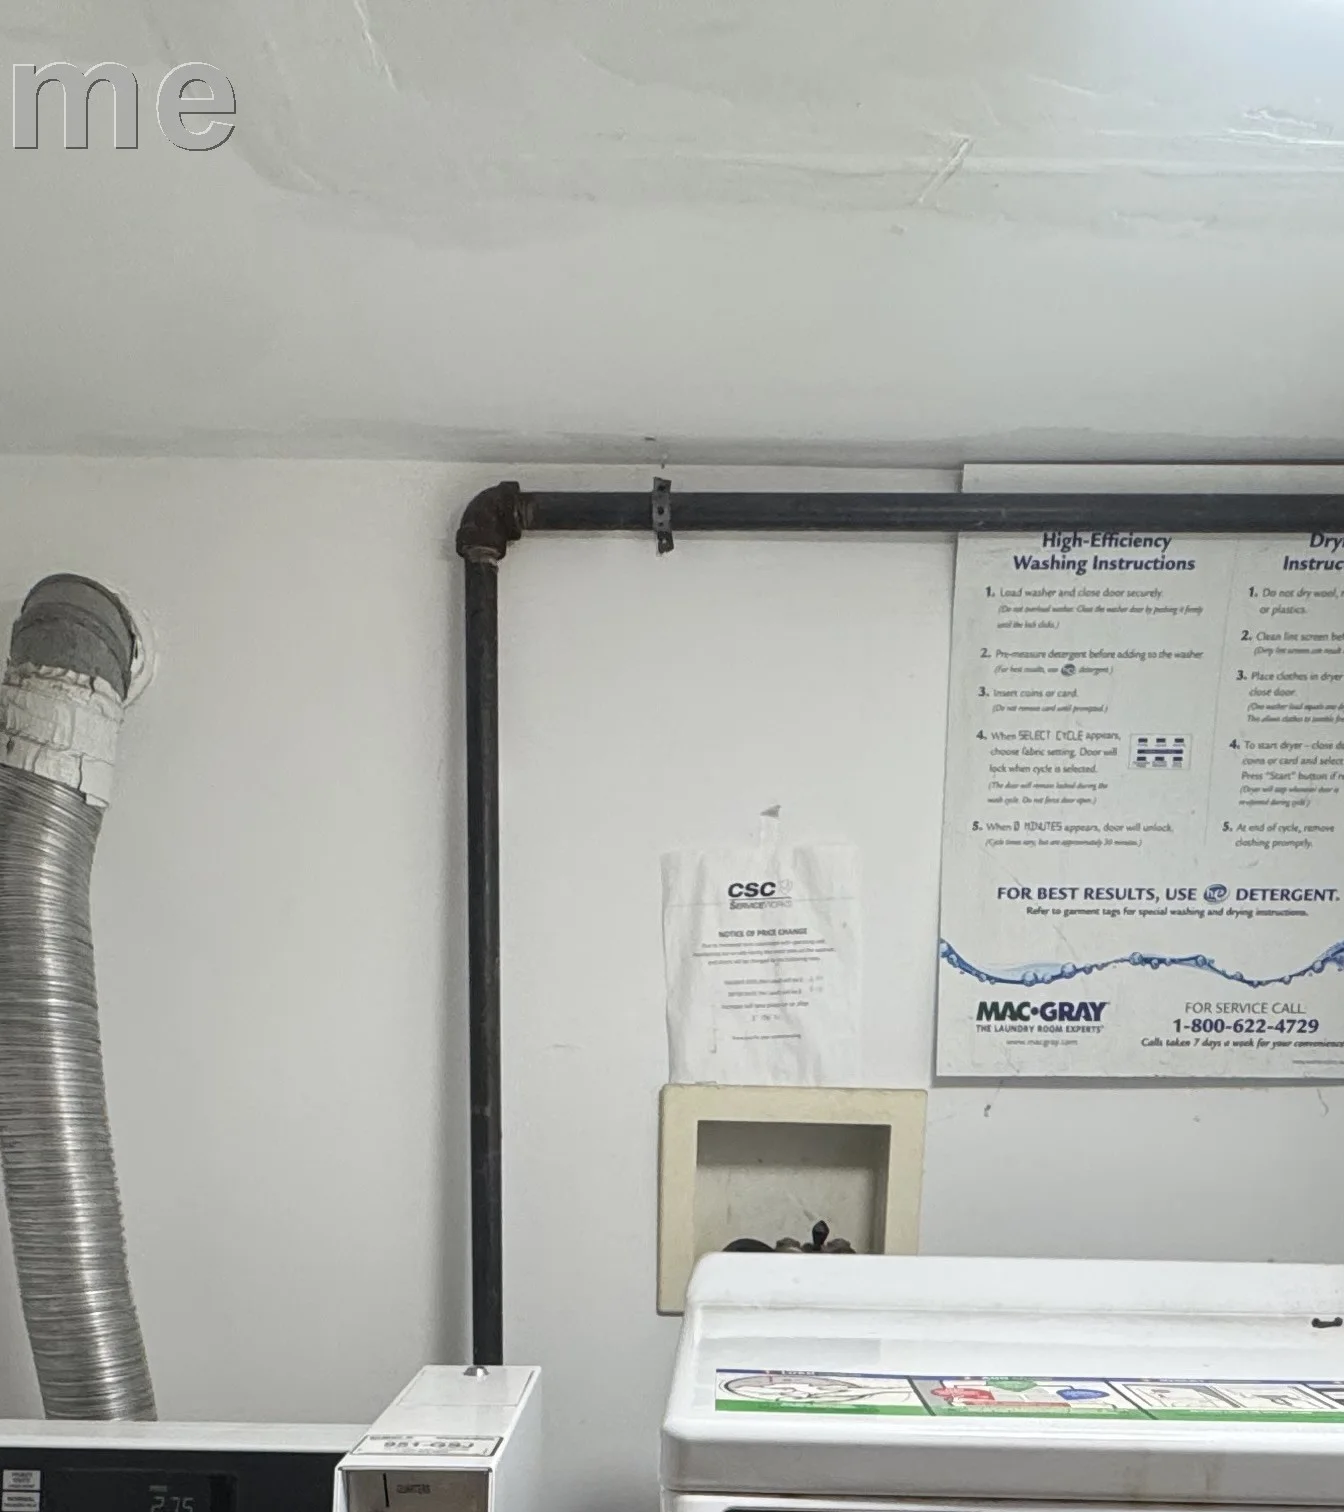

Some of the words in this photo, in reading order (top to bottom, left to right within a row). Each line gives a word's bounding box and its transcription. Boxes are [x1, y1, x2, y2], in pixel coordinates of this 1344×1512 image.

[1042, 532, 1172, 552] High-Efficiency
[1013, 555, 1088, 575] Washing
[1092, 554, 1196, 570] Instructions
[985, 586, 996, 597] 1.
[1000, 587, 1023, 598] Load
[1024, 587, 1057, 598] washer
[1058, 587, 1076, 598] and
[1077, 587, 1101, 598] close
[1102, 587, 1125, 598] door
[978, 686, 990, 698] 3.
[993, 688, 1018, 698] Insert
[1019, 688, 1044, 698] coins
[1045, 688, 1056, 698] or
[1056, 688, 1079, 698] card.
[976, 730, 987, 741] 4.
[991, 731, 1017, 741] When
[1018, 730, 1050, 741] SELECT
[1055, 731, 1083, 741] CYCLE
[1085, 732, 1122, 743] appears,
[972, 821, 984, 832] 5.
[986, 821, 1013, 832] When
[1013, 821, 1020, 832] 0
[1024, 821, 1062, 832] MINUTES
[1063, 823, 1101, 834] appears,
[1103, 822, 1125, 832] door
[1126, 822, 1141, 832] will
[1142, 822, 1173, 833] unlock.
[728, 881, 776, 898] CSC
[997, 887, 1035, 901] FOR
[1037, 887, 1079, 901] BEST
[1083, 887, 1160, 903] RESULTS,
[1165, 887, 1197, 901] USE
[1236, 888, 1341, 902] DETERGENT.
[1026, 907, 1050, 916] Refer
[1052, 907, 1061, 916] to
[1063, 908, 1100, 917] garment
[1102, 908, 1121, 917] tags
[1123, 907, 1137, 916] for
[1138, 907, 1167, 917] special
[1170, 907, 1205, 917] washing
[1207, 907, 1224, 916] and
[1226, 907, 1253, 918] drying
[1185, 1002, 1214, 1015] FOR
[1216, 1002, 1267, 1015] SERVICE
[1271, 1002, 1304, 1015] CALL
[977, 1025, 994, 1034] THE
[996, 1025, 1034, 1034] LAUNDRY
[1038, 1025, 1063, 1034] ROOM
[1066, 1025, 1103, 1034] EXPERTS
[1172, 1018, 1319, 1034] 1-800-622-4729
[1141, 1037, 1162, 1047] Calls
[1165, 1037, 1190, 1047] taken
[1194, 1037, 1200, 1047] 7
[1202, 1038, 1222, 1049] days
[1232, 1037, 1255, 1047] week
[1256, 1038, 1270, 1049] for
[1271, 1040, 1292, 1049] your
